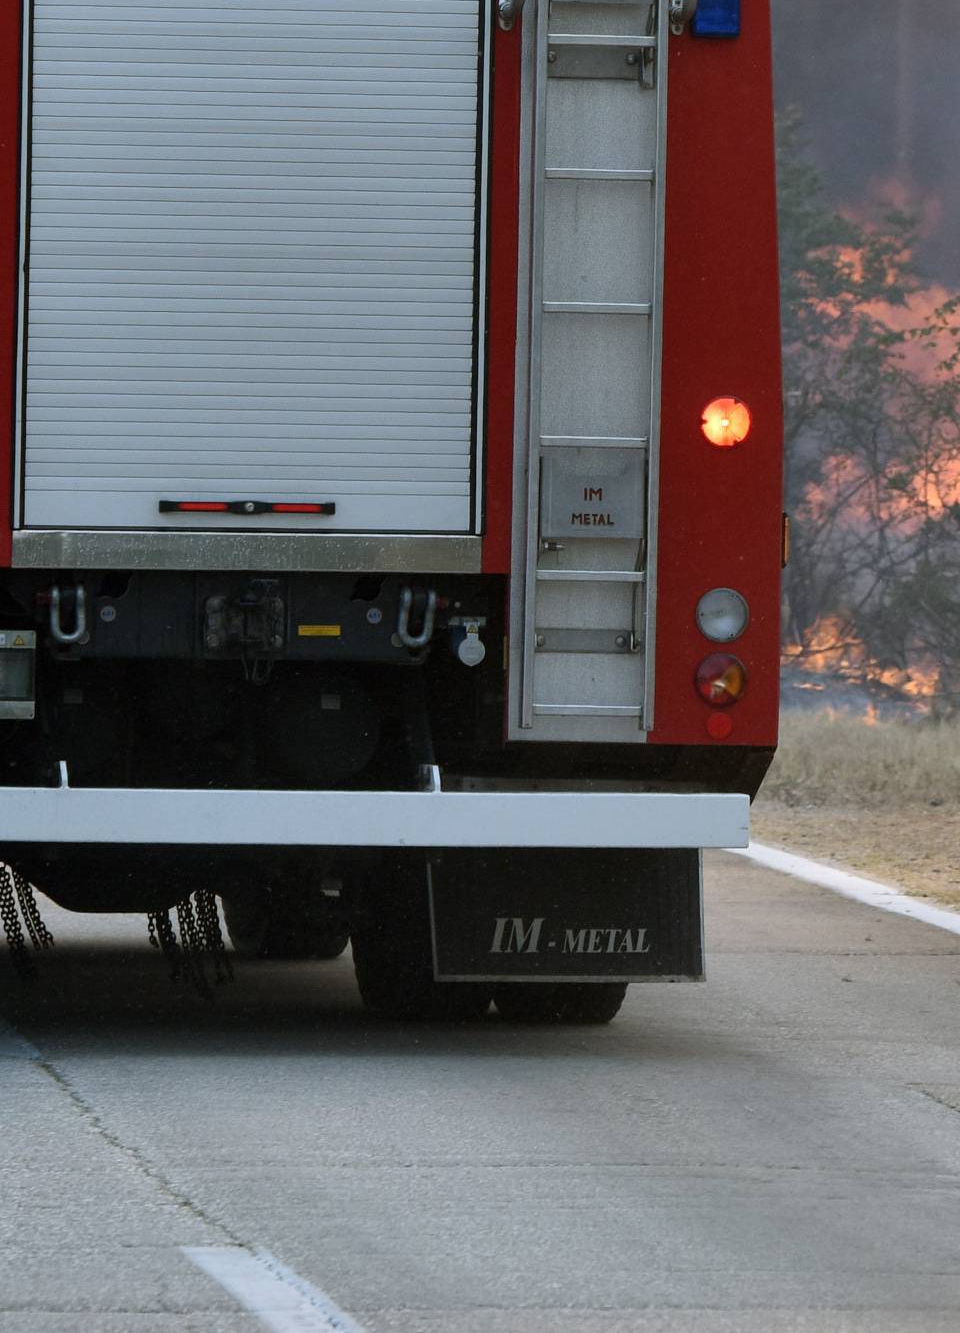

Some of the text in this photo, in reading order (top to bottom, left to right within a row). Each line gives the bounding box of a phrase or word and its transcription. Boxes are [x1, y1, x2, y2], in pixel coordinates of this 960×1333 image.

[583, 487, 603, 502] IM
[571, 513, 615, 526] METAL
[489, 917, 546, 954] IM
[561, 927, 651, 954] METAL
